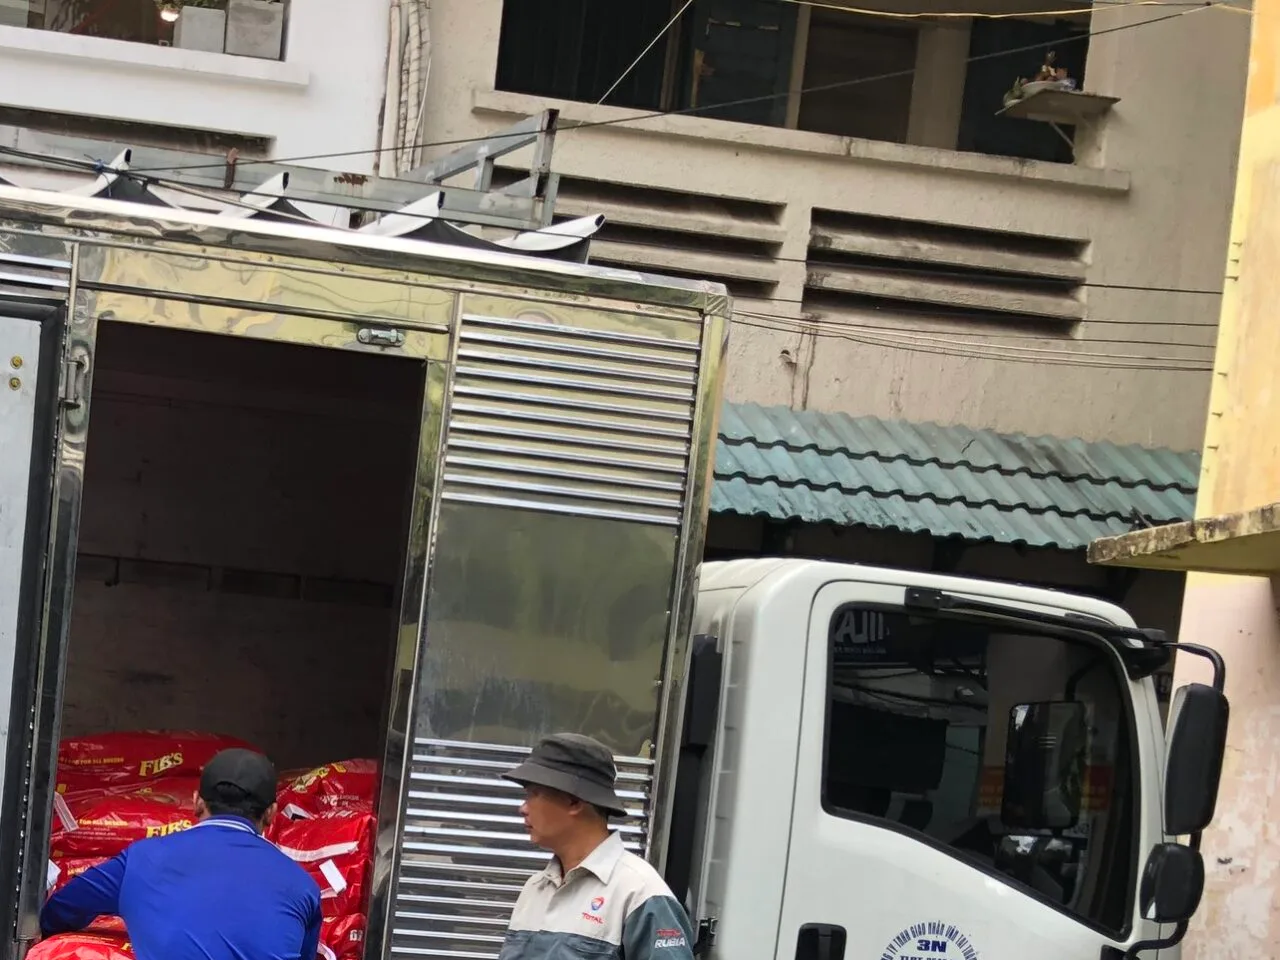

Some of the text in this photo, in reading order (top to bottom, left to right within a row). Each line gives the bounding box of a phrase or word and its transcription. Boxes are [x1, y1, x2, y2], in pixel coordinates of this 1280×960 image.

[582, 912, 604, 924] TOTAL
[655, 937, 686, 948] RUBIA
[886, 943, 898, 955] TY
[893, 929, 911, 948] TNHH
[910, 922, 926, 938] GIAO
[917, 939, 946, 952] 3N
